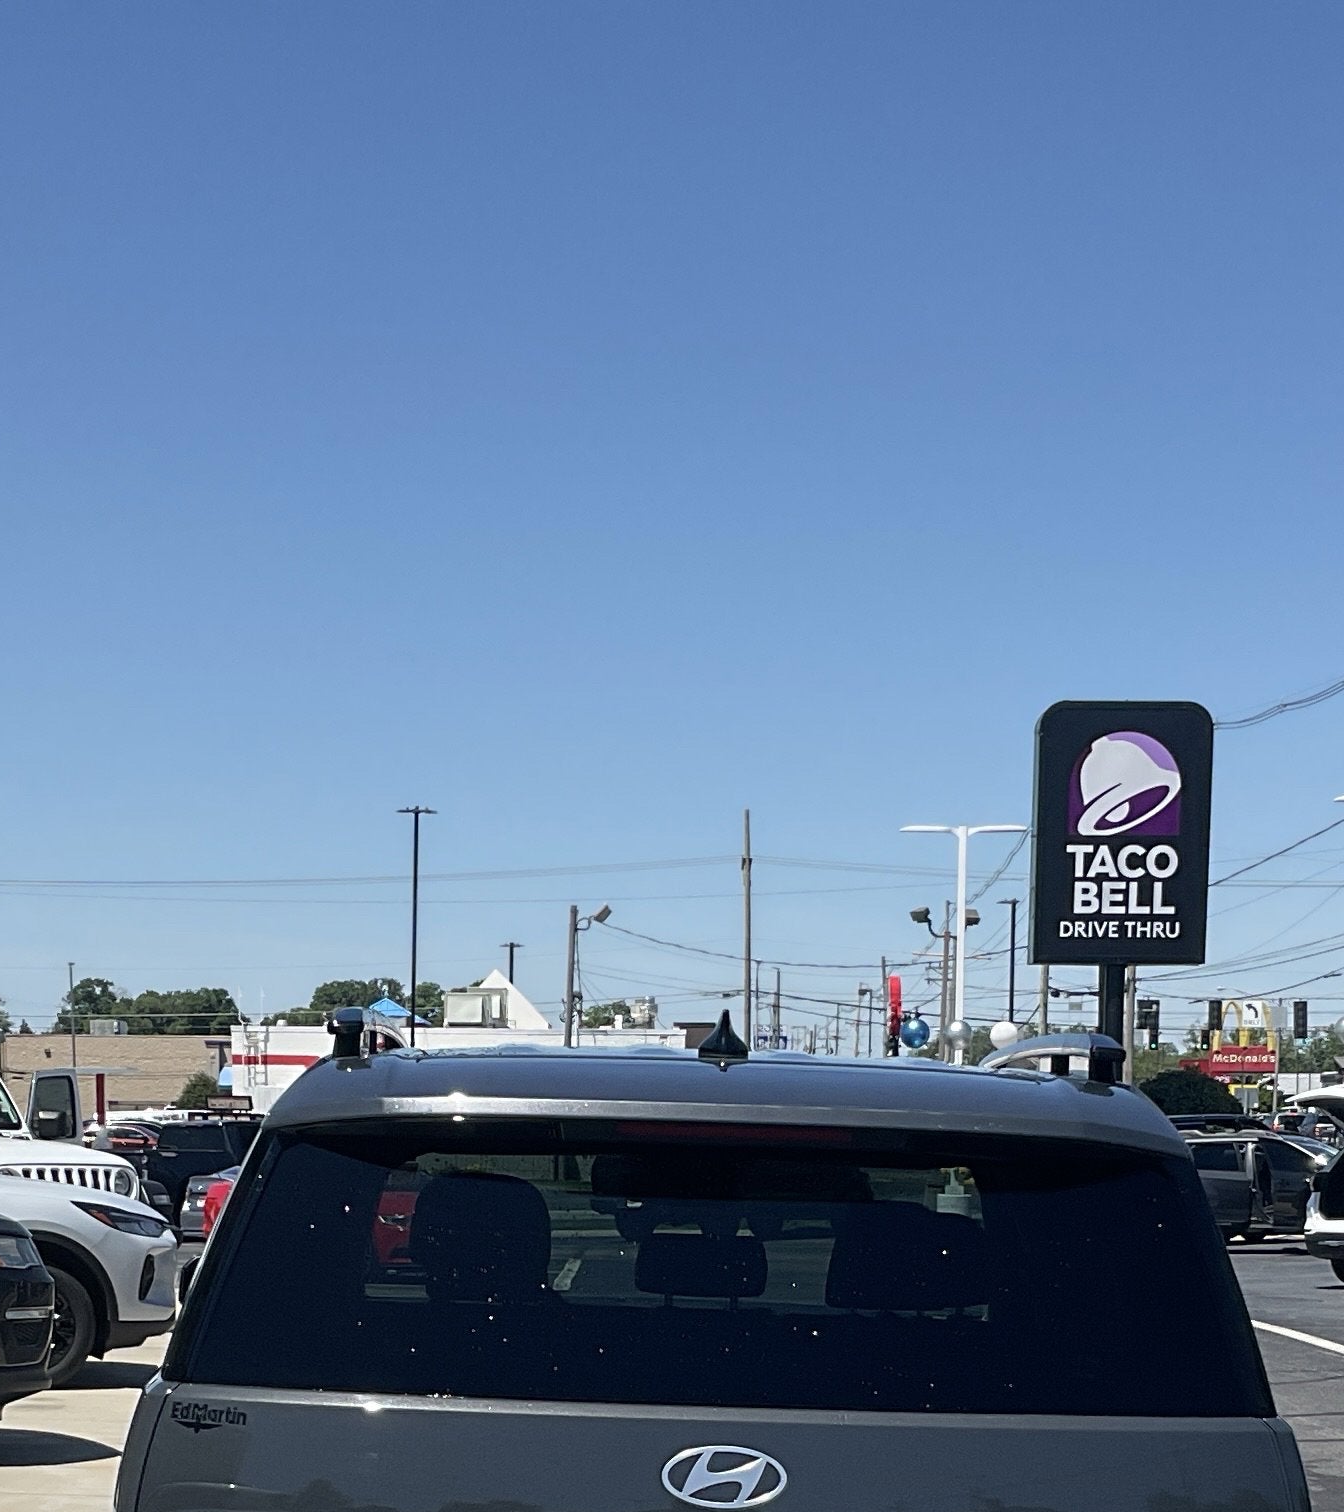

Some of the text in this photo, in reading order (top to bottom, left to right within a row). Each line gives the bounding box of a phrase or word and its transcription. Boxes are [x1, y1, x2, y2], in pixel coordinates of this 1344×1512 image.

[1066, 844, 1179, 879] TACO
[1073, 881, 1176, 915] BELL
[1059, 921, 1181, 939] DRIVE THRU
[1212, 1053, 1276, 1064] McDonald's
[170, 1401, 248, 1426] EdMartin
